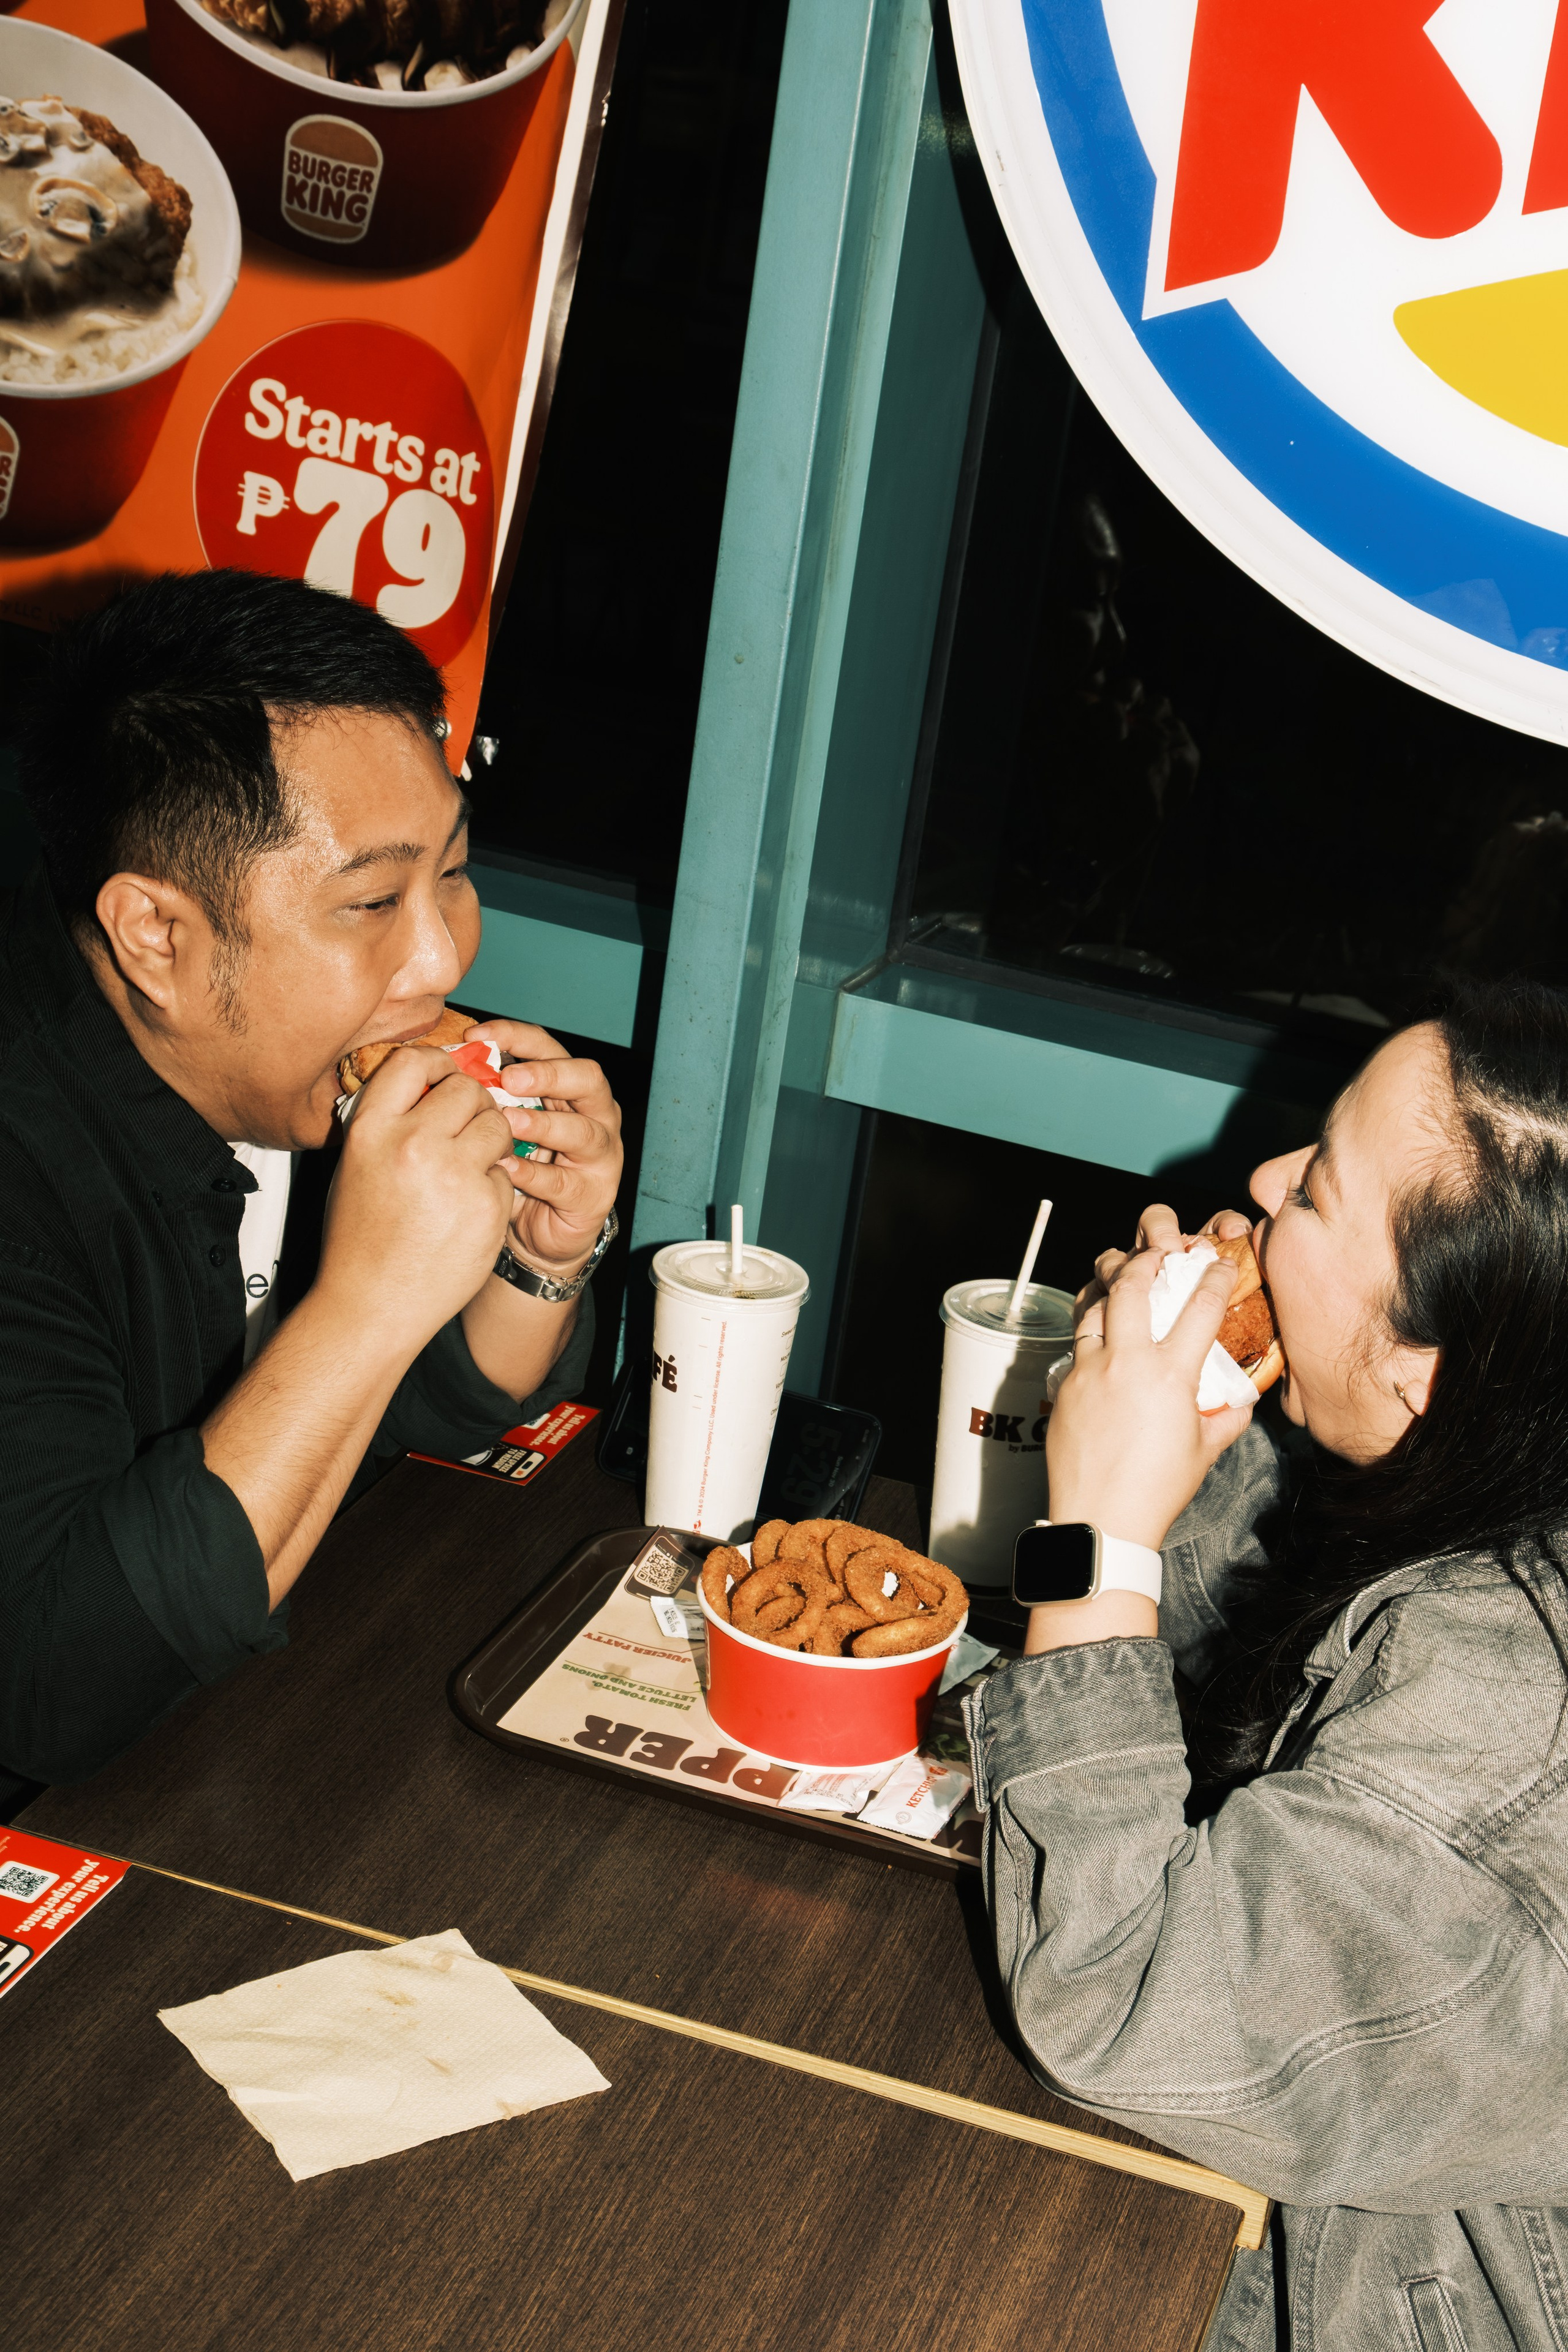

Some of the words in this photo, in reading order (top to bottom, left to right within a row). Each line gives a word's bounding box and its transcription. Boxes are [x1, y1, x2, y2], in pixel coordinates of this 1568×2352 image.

[288, 149, 374, 194] BURGER
[285, 174, 369, 223] KING
[245, 377, 423, 483] Starts
[430, 447, 481, 505] at
[652, 1351, 677, 1393] FÉ
[559, 1405, 577, 1420] your
[568, 1414, 586, 1425] Tell
[529, 1417, 564, 1446] experience.
[970, 1408, 1025, 1443] BK
[547, 1429, 568, 1445] about
[705, 1430, 714, 1455] Company
[513, 1449, 527, 1461] FREE
[1008, 1444, 1020, 1453] by
[491, 1453, 511, 1469] MEDIUM
[499, 1457, 518, 1473] UPSIZE
[780, 1422, 842, 1507] 5:29
[828, 1478, 835, 1487] 30
[831, 1468, 840, 1479] Nov
[582, 1632, 633, 1651] PATTY
[632, 1646, 692, 1664] JUICIER
[562, 1664, 609, 1680] ONIONS
[592, 1680, 647, 1701] TOMATO,
[610, 1677, 638, 1688] AND
[638, 1685, 697, 1703] LETTUCE
[648, 1697, 692, 1711] FRESH
[573, 1714, 800, 1800] PPER
[906, 1776, 937, 1808] KETCHUP
[71, 1858, 100, 1883] your
[80, 1874, 110, 1893] Tell
[69, 1890, 89, 1903] us
[13, 1882, 77, 1933] experience.
[40, 1901, 77, 1929] about
